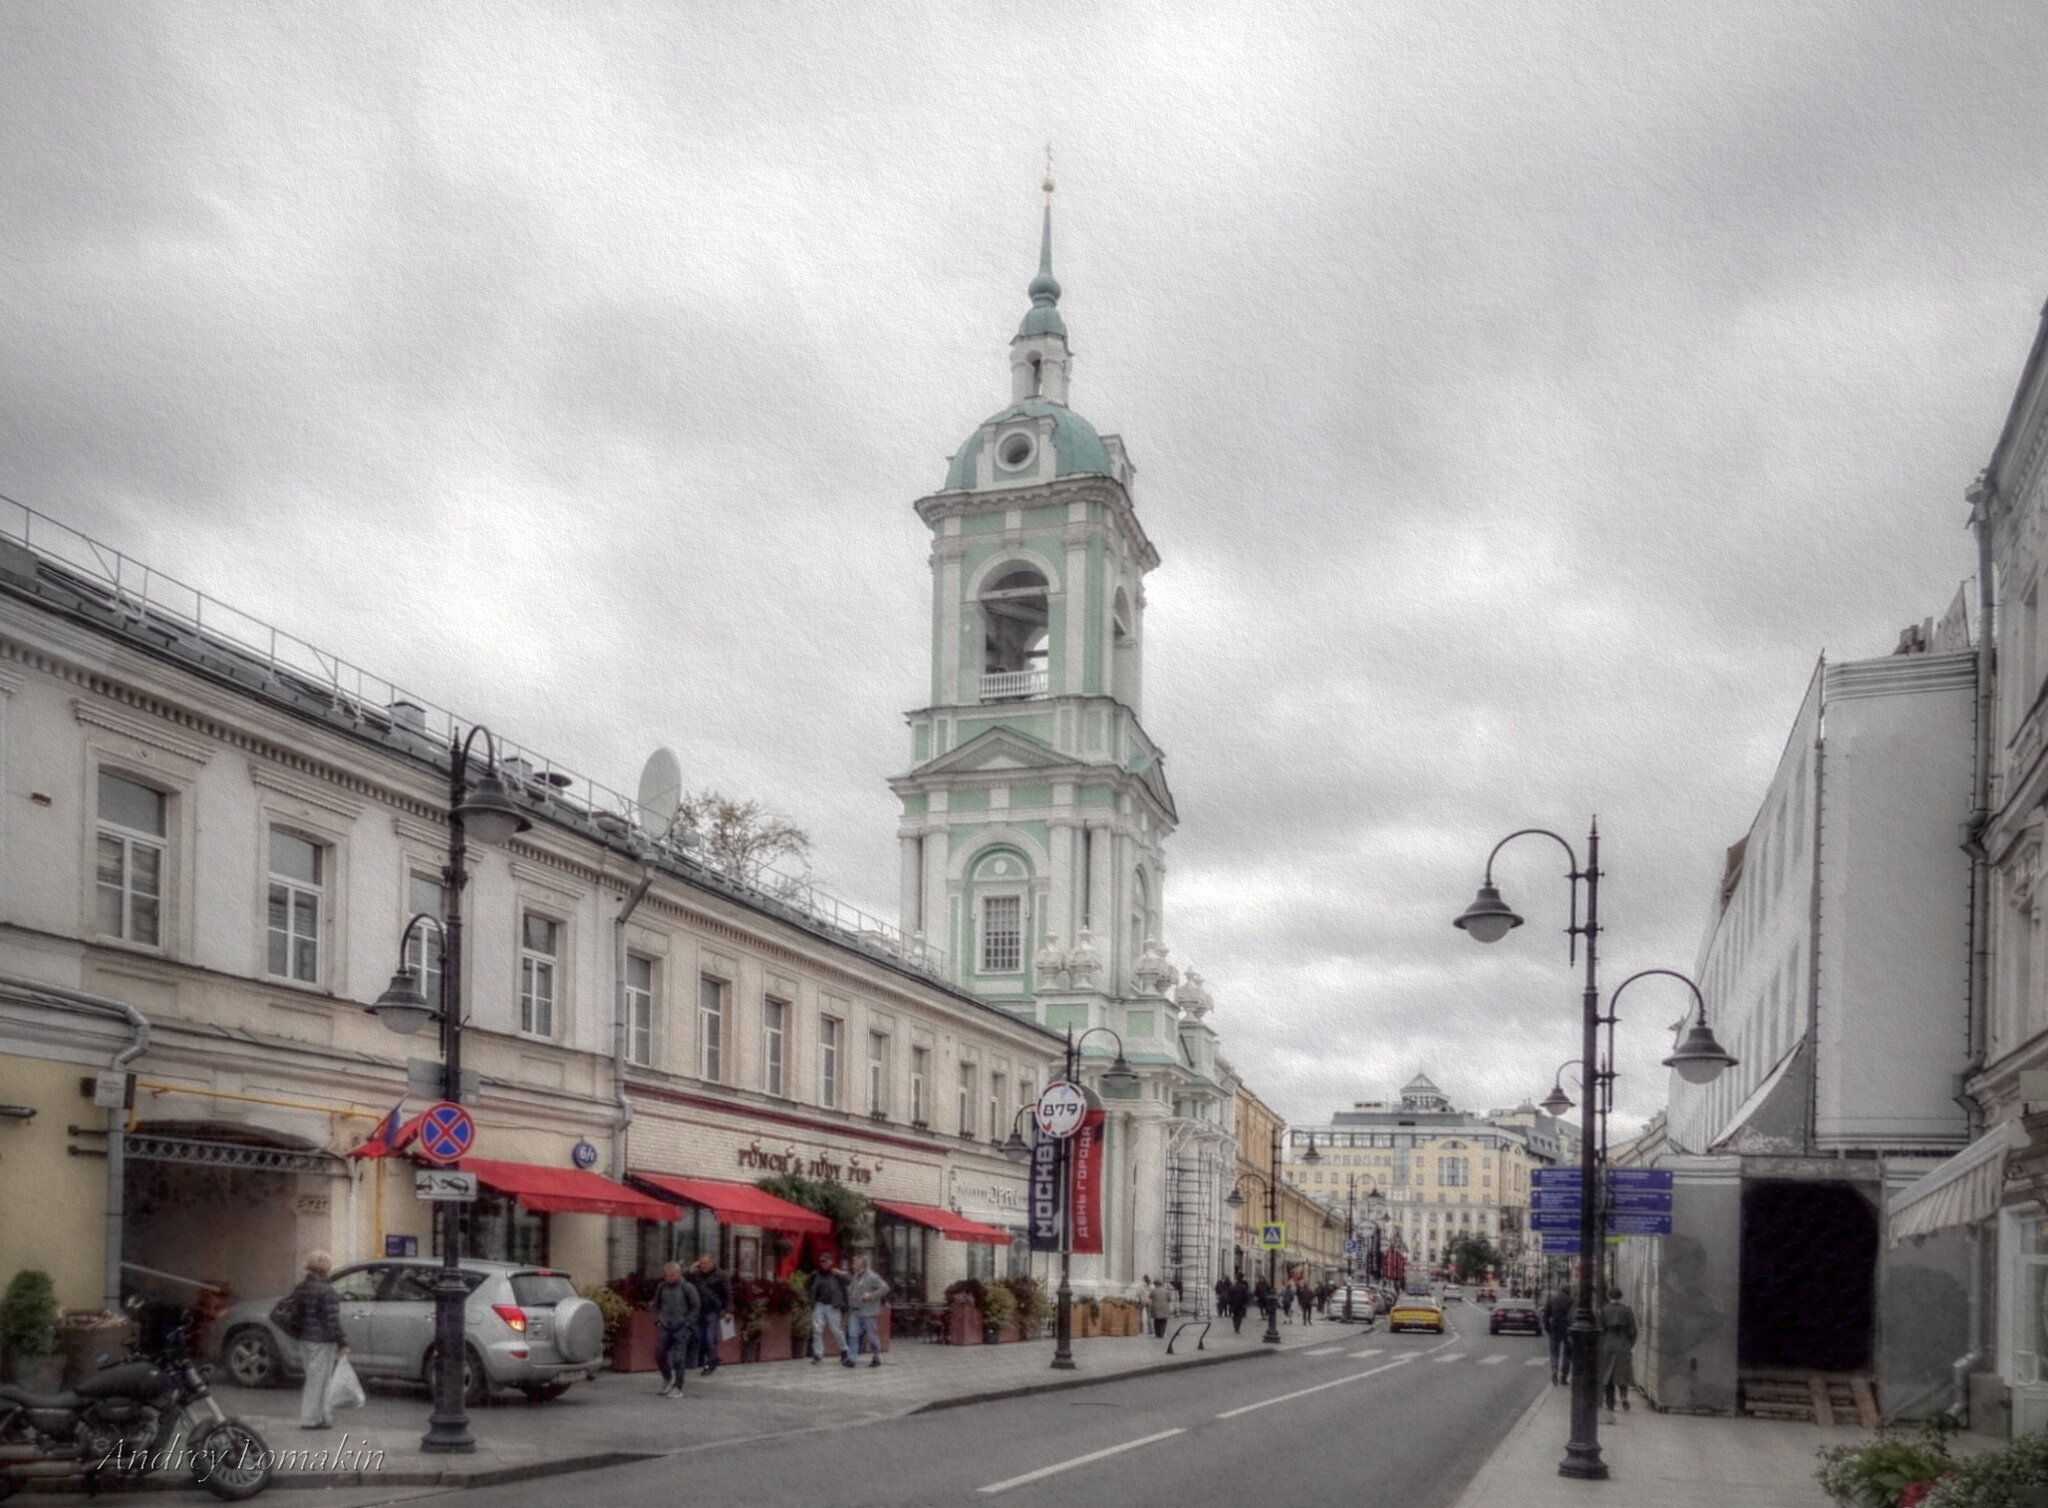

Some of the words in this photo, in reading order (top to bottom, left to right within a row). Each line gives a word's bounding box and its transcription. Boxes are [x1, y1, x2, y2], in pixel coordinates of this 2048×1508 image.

[738, 1148, 788, 1173] PUNCH
[808, 1159, 841, 1180] JUDY
[847, 1165, 872, 1184] PUB
[1077, 1126, 1092, 1190] ГОРОДА
[1077, 1194, 1089, 1238] ДЕНЬ
